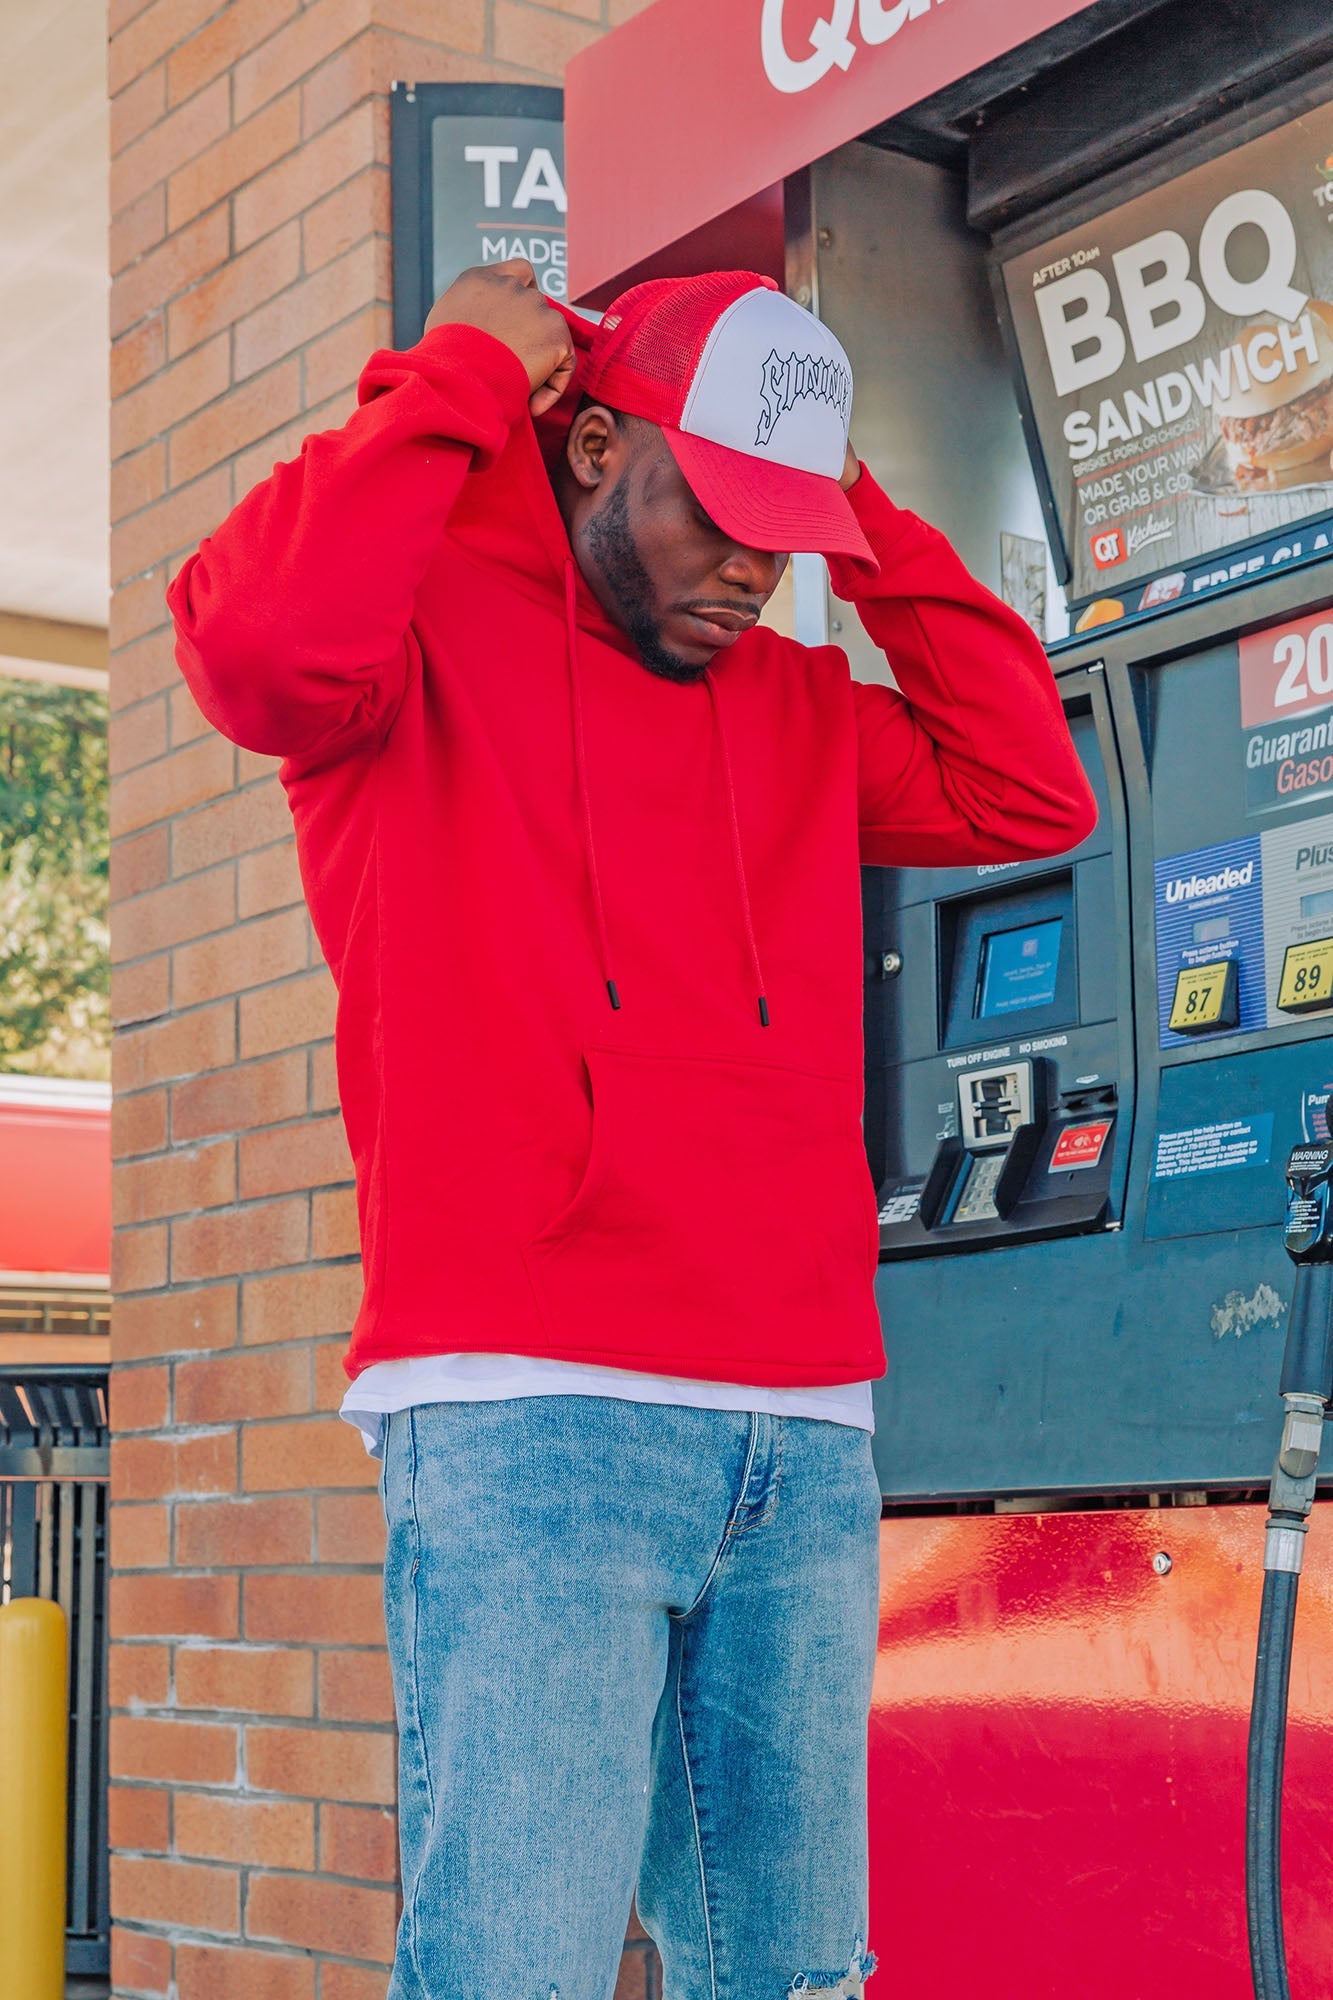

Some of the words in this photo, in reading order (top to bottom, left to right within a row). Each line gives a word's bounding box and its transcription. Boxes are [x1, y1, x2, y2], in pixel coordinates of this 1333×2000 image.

[482, 236, 568, 267] MADE
[1032, 257, 1072, 287] AFTER
[1034, 189, 1309, 397] BBQ
[1063, 313, 1319, 460] SANDWICH
[1078, 472, 1126, 505] MADE
[1125, 455, 1171, 487] YOUR
[1170, 442, 1205, 470] WAY
[1084, 503, 1109, 525] OR
[1108, 487, 1151, 516] GRAB
[1153, 481, 1164, 500] &
[1166, 471, 1190, 494] GO
[1095, 533, 1120, 562] QT
[1273, 623, 1333, 708] 20
[1165, 861, 1253, 903] Unleaded
[1294, 964, 1321, 993] 89
[1185, 987, 1212, 1015] 87
[946, 1056, 967, 1068] TURN
[967, 1052, 982, 1064] OFF
[982, 1046, 1010, 1061] ENGINE
[1019, 1043, 1031, 1054] NO
[1031, 1035, 1068, 1052] SMOKING
[1291, 1149, 1329, 1161] WARNING
